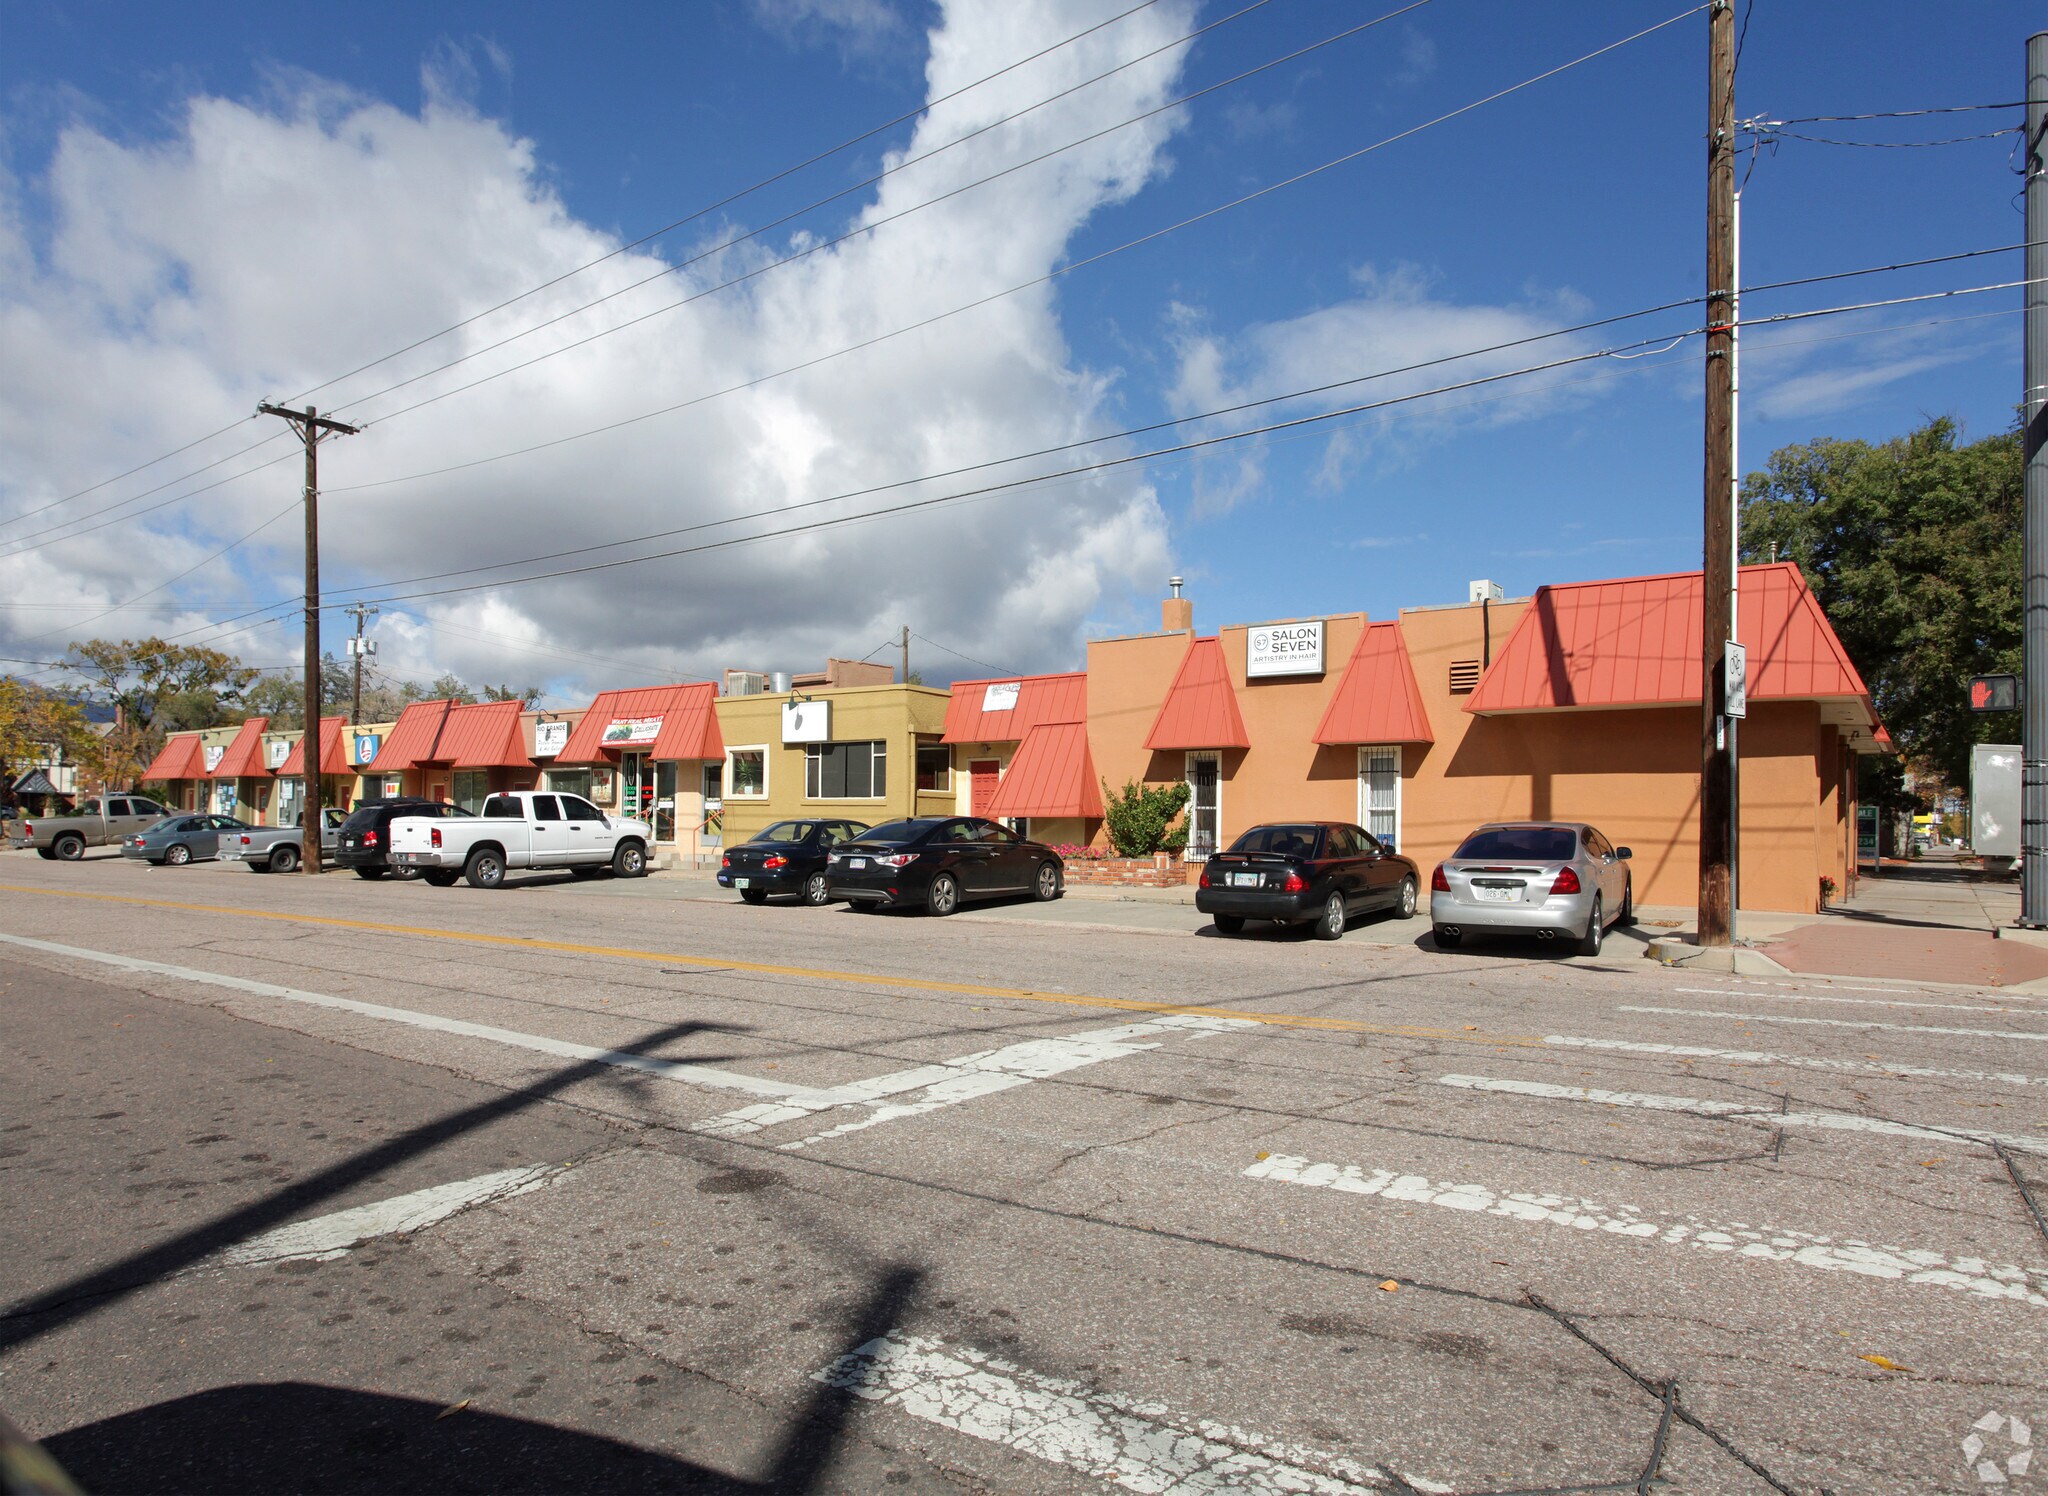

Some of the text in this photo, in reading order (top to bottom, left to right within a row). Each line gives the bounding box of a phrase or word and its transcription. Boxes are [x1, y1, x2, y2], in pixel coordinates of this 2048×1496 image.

[1272, 628, 1316, 640] SALON
[1256, 639, 1267, 647] S7
[1271, 640, 1317, 653] SEVEN
